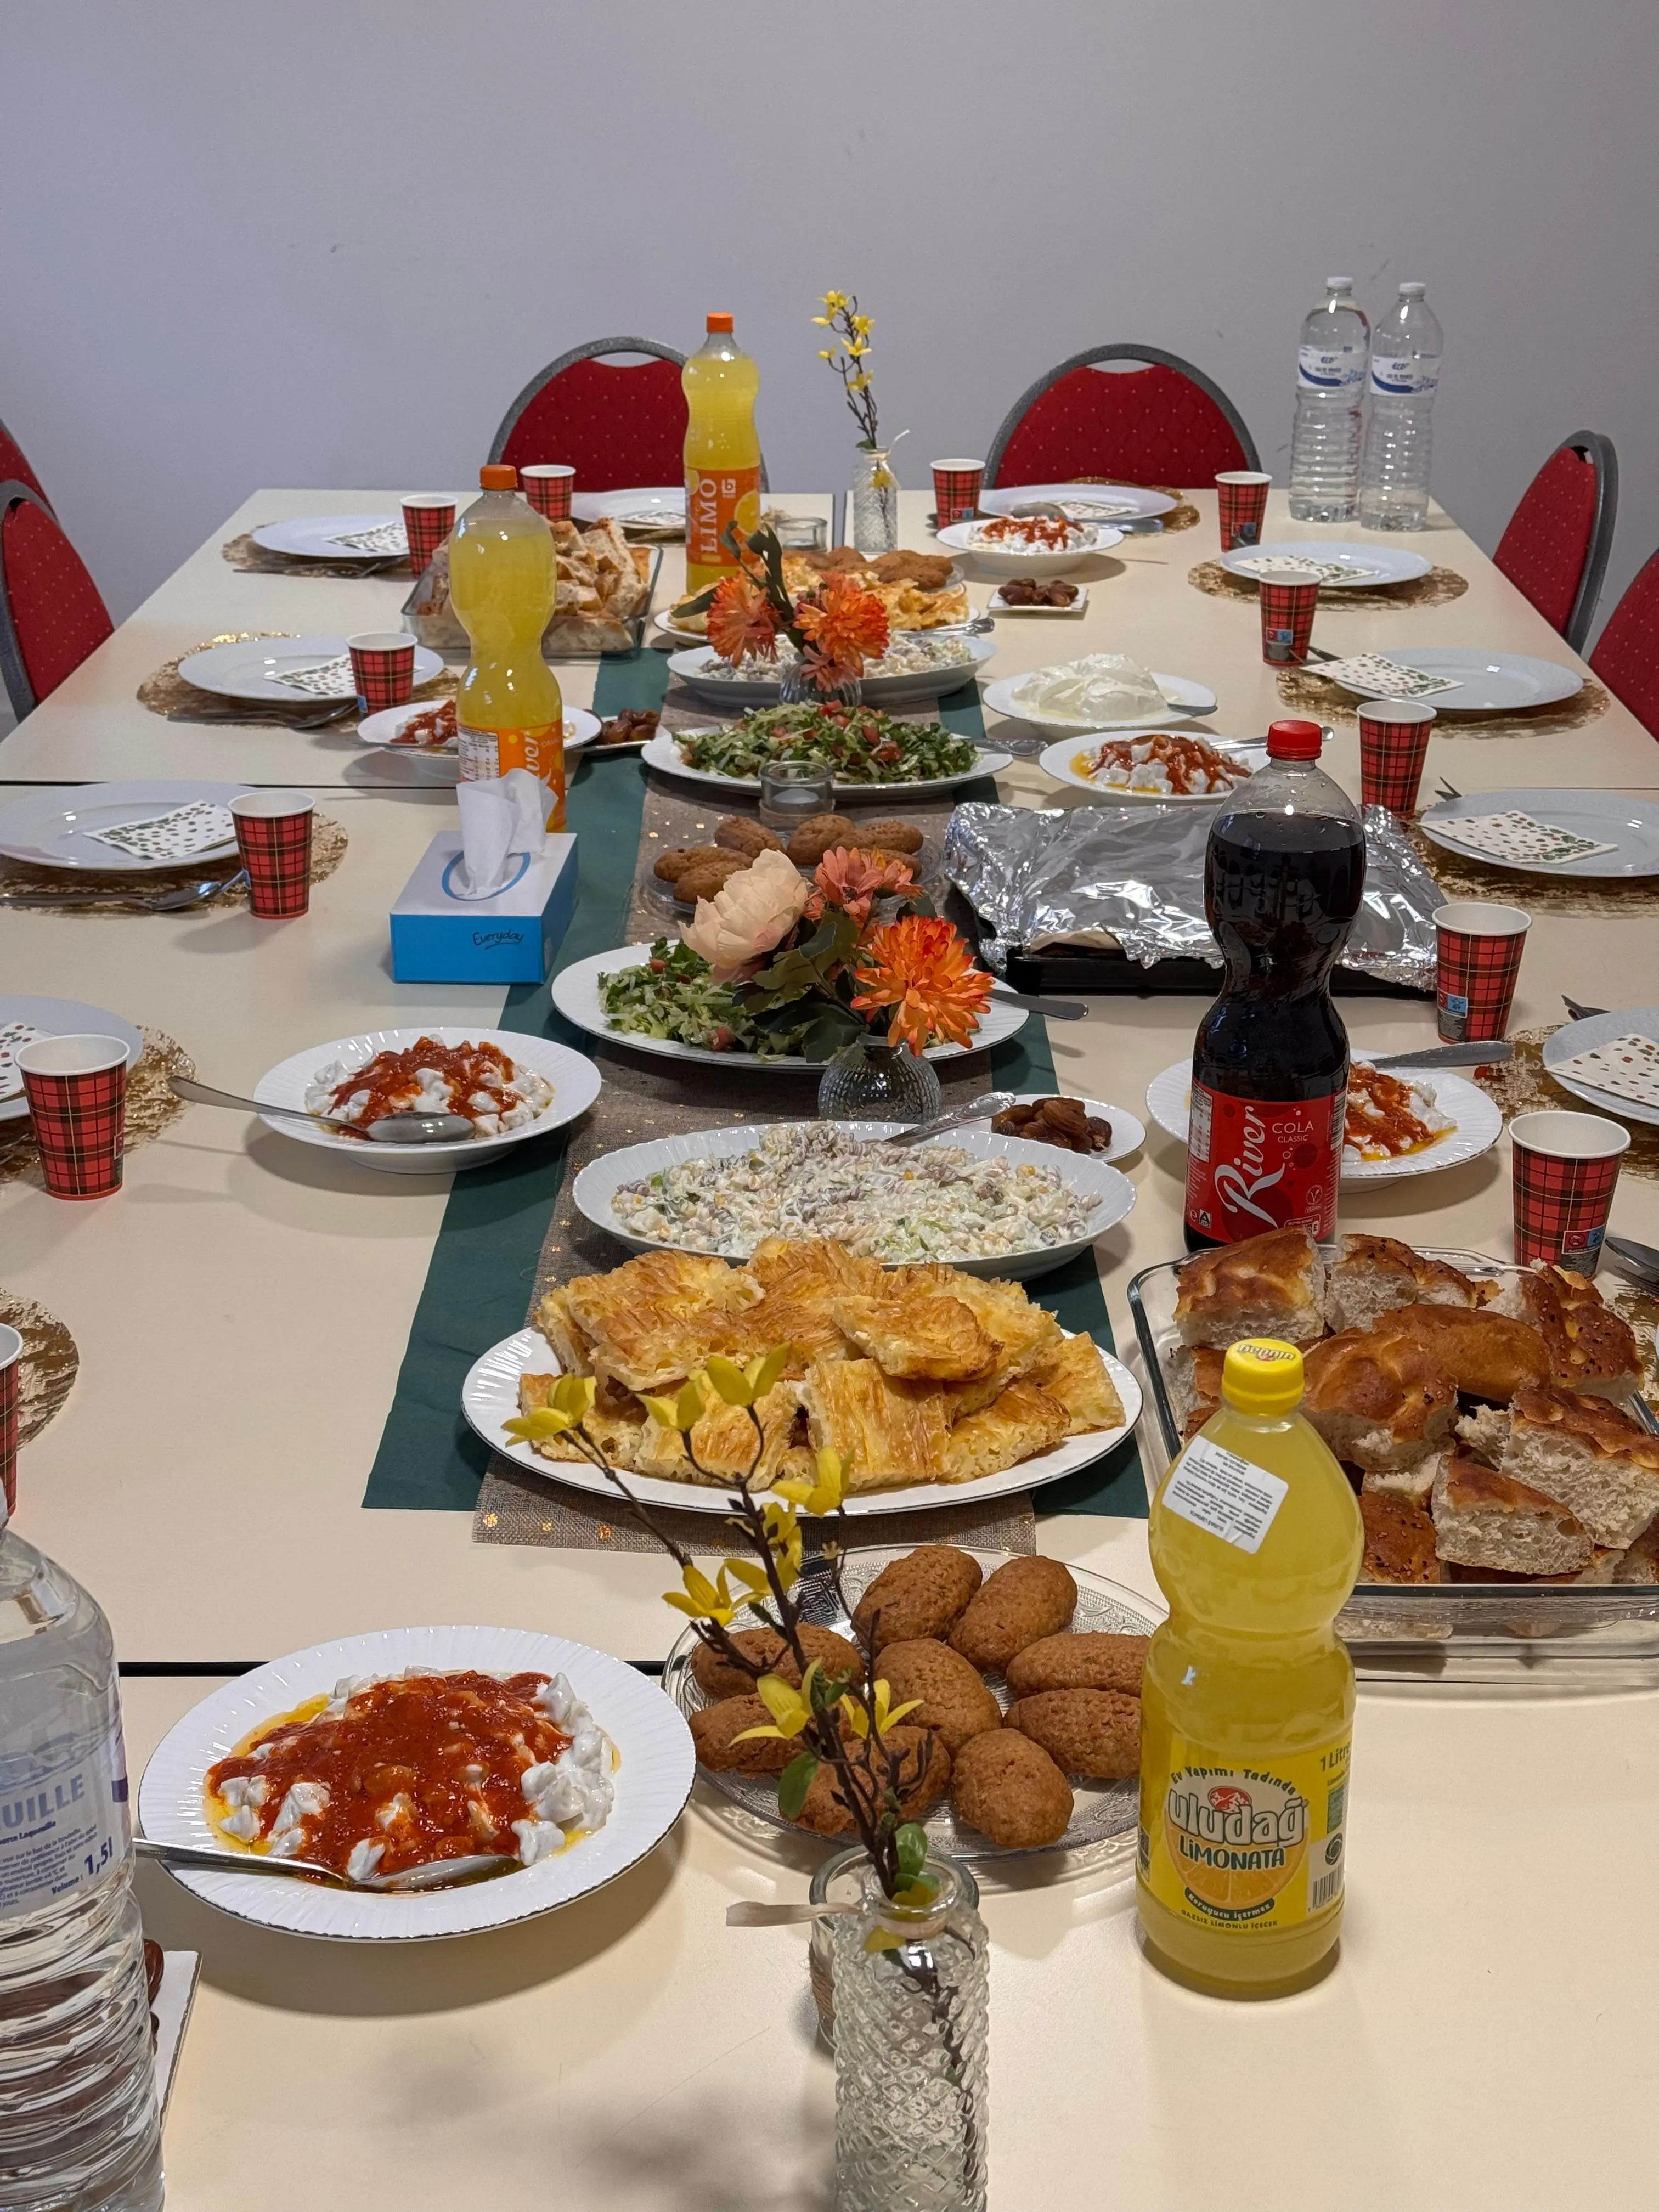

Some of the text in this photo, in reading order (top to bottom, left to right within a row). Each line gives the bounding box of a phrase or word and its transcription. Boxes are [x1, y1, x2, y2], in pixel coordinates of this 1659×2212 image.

[699, 478, 718, 553] LIMO
[473, 928, 524, 946] Everyday
[1272, 1121, 1314, 1133] COLA
[1278, 1134, 1309, 1143] CLASSIC
[1214, 1105, 1285, 1229] River
[1320, 1756, 1326, 1772] 1
[1171, 1766, 1296, 1796] Ev Yapımı Tadında
[2, 1773, 84, 1829] UILLE
[52, 1877, 79, 1894] Volume
[1188, 1893, 1229, 1918] Koruyucu
